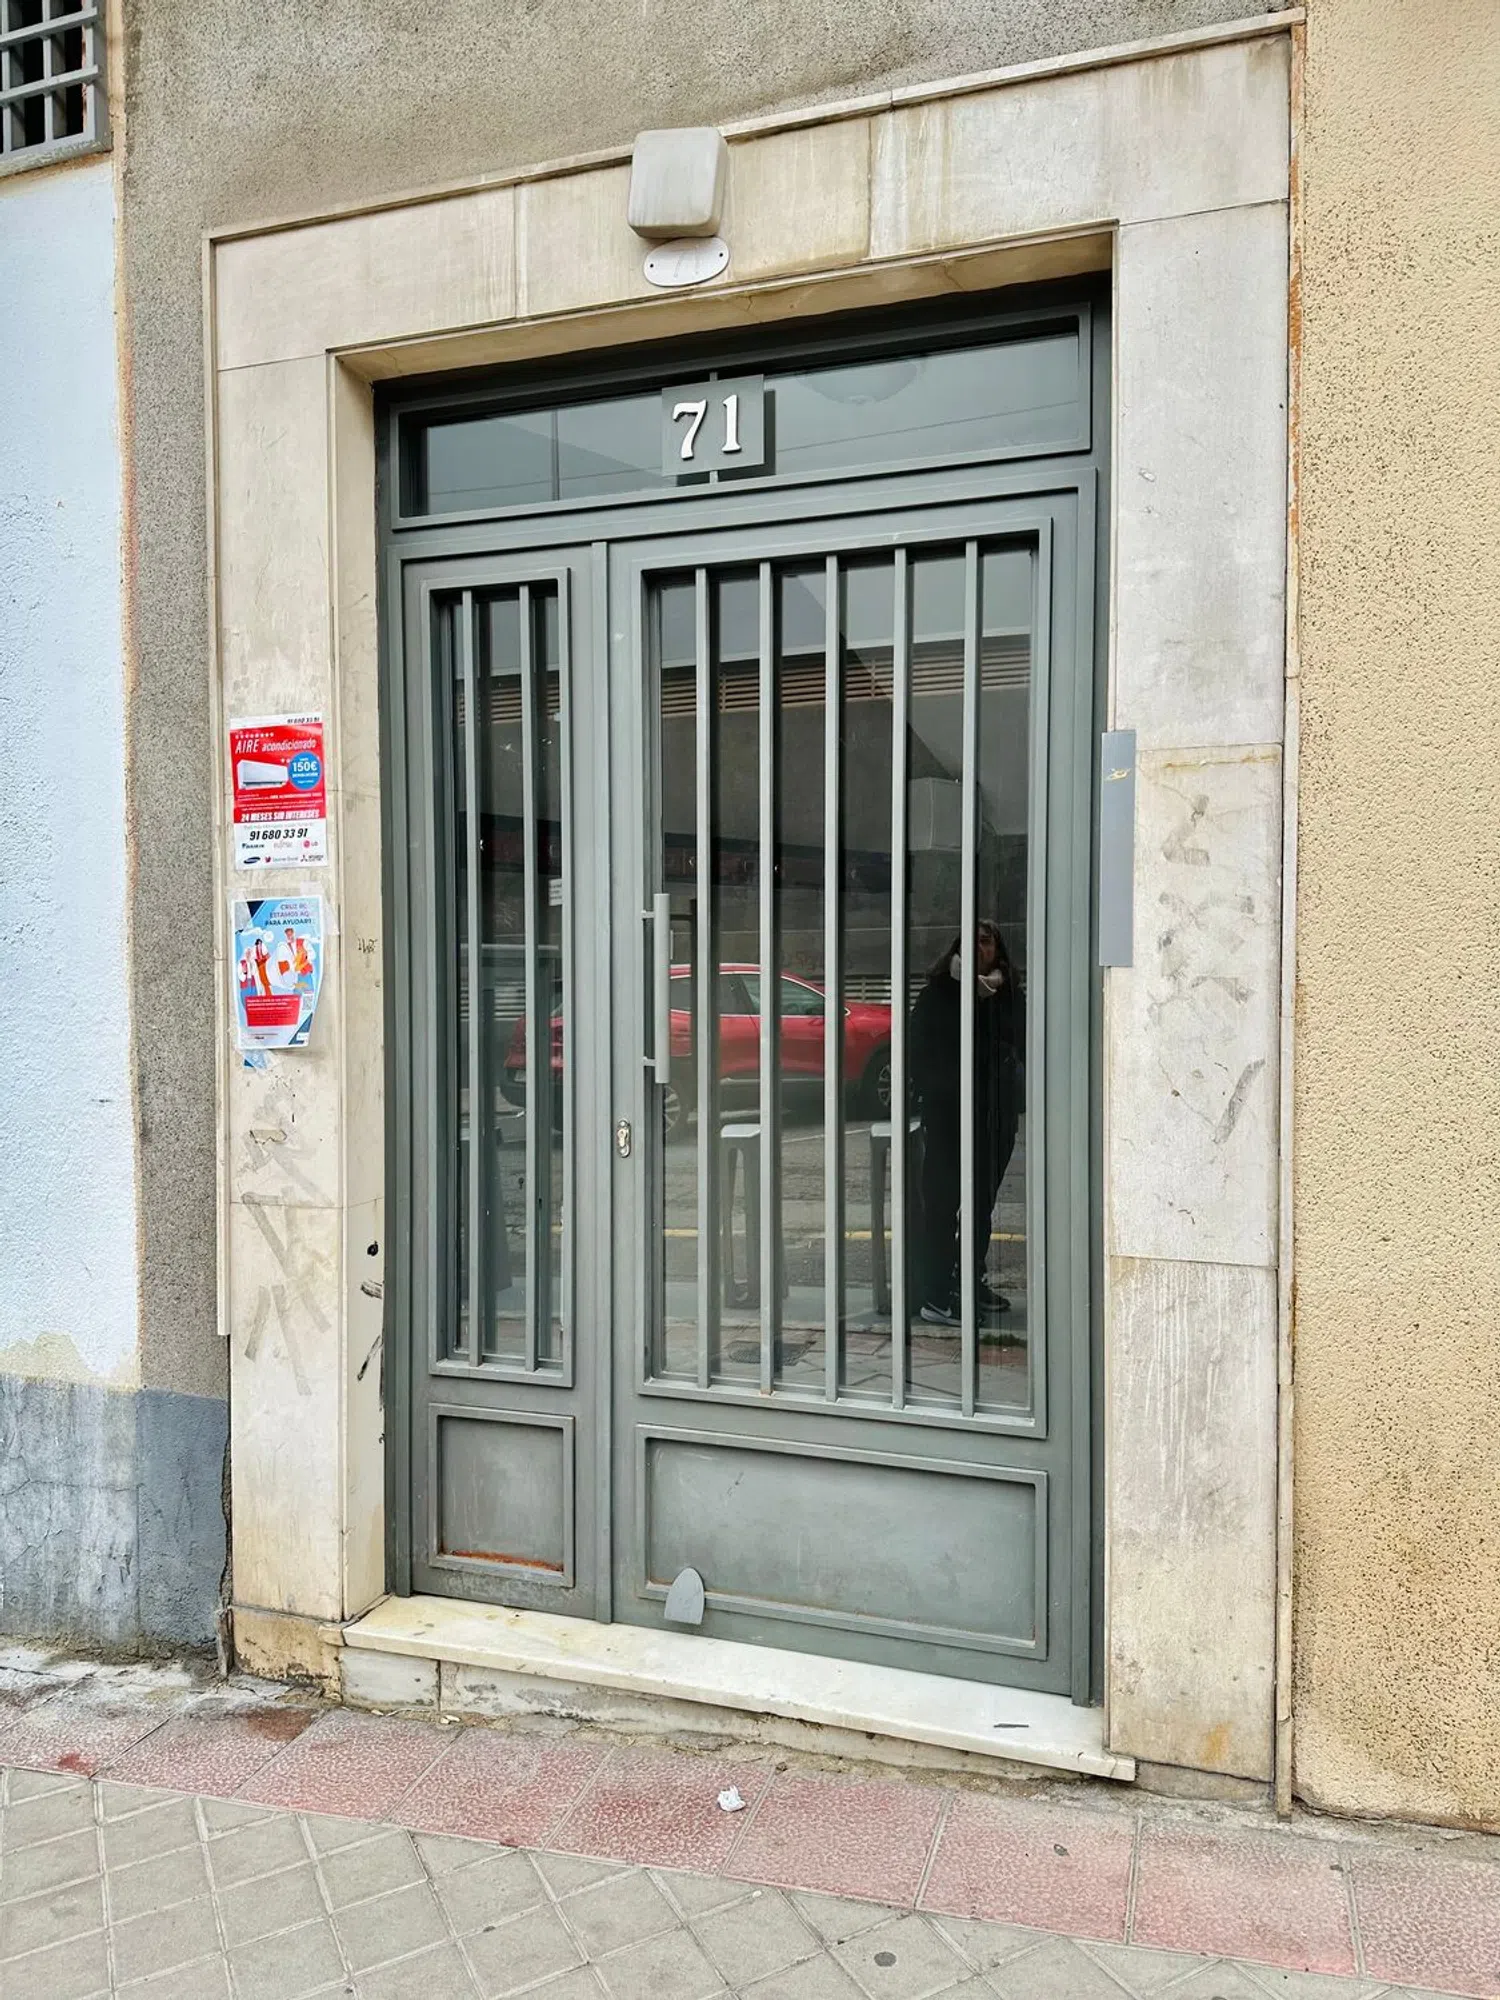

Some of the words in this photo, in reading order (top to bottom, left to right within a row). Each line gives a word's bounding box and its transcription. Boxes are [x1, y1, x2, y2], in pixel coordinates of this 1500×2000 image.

[672, 394, 741, 460] 71
[235, 739, 260, 754] AIRE
[262, 738, 317, 752] acondicionado
[292, 761, 318, 772] 150€
[250, 811, 273, 821] MESES
[273, 811, 285, 820] SIN
[285, 809, 320, 819] INTERESES
[249, 830, 260, 841] 91
[261, 829, 282, 840] 680
[282, 828, 296, 839] 33
[297, 828, 308, 838] 91
